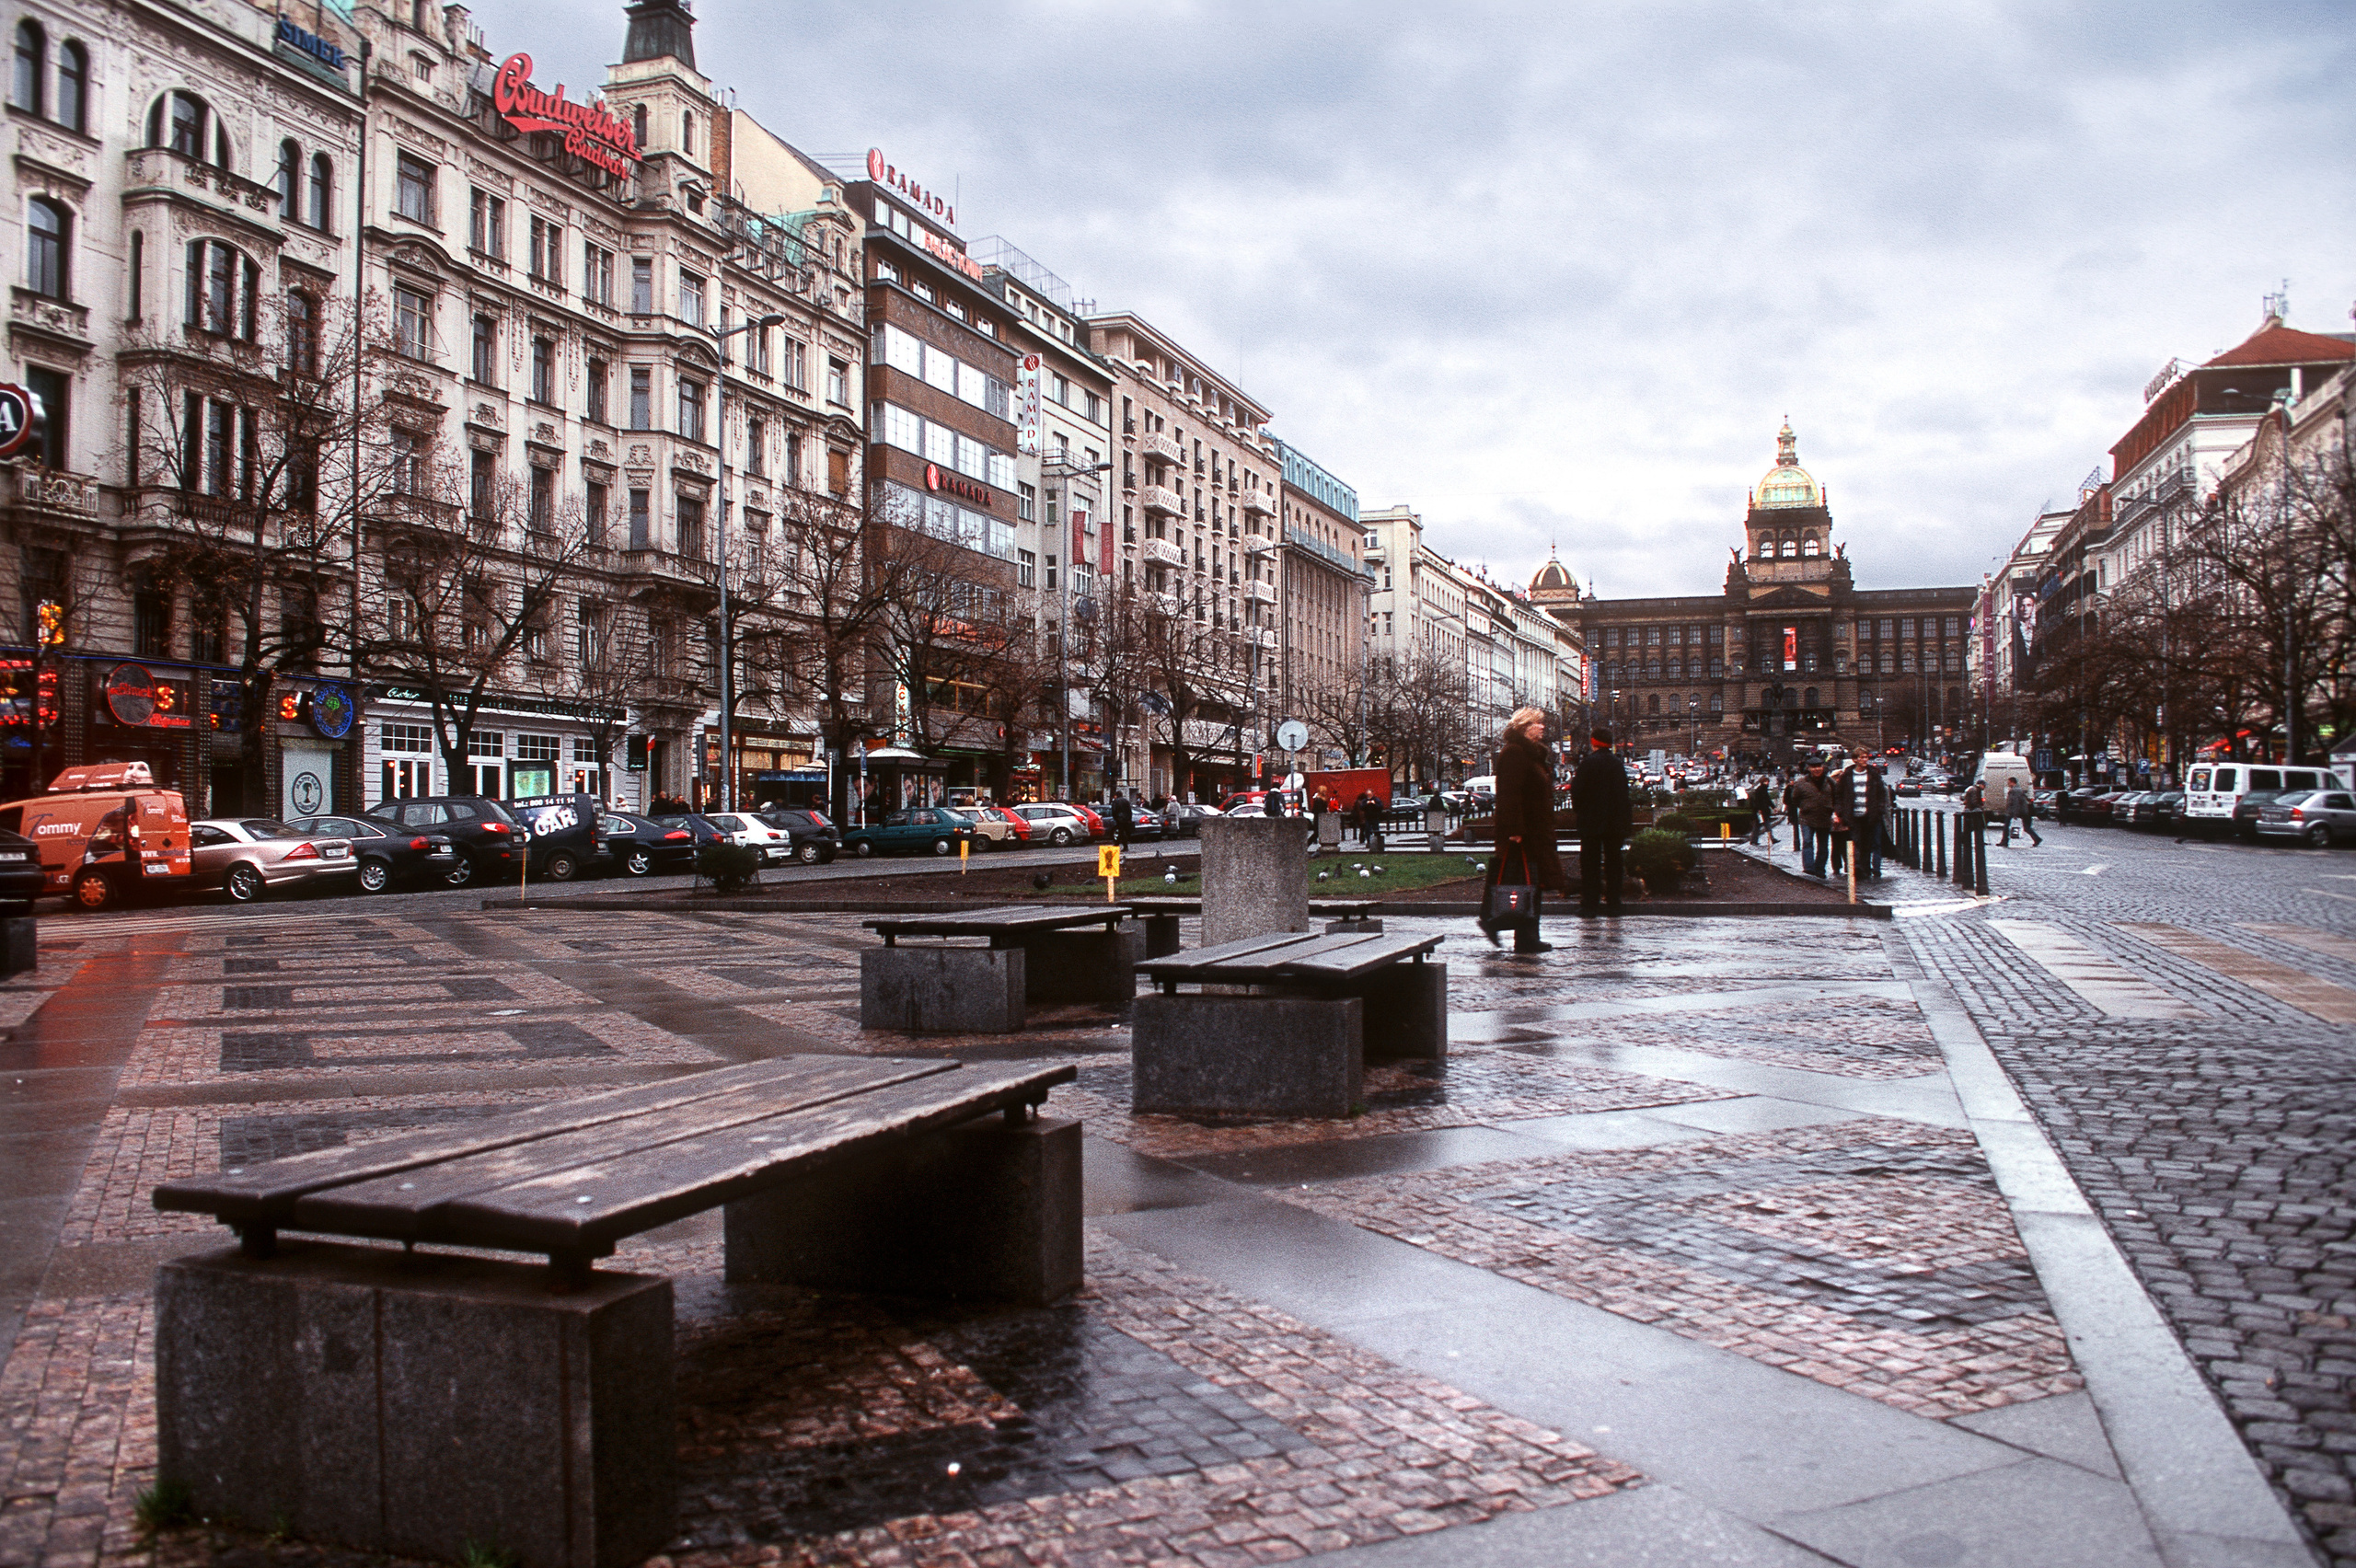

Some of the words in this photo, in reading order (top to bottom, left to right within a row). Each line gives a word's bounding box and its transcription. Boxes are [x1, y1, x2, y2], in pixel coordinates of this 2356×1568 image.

[495, 52, 638, 156] Budweiser
[887, 165, 954, 225] RAMADA
[1025, 377, 1037, 453] RAMADA
[941, 474, 993, 507] RAMADA
[567, 796, 576, 804] 14
[28, 813, 82, 839] Tommy
[535, 808, 578, 836] CAR
